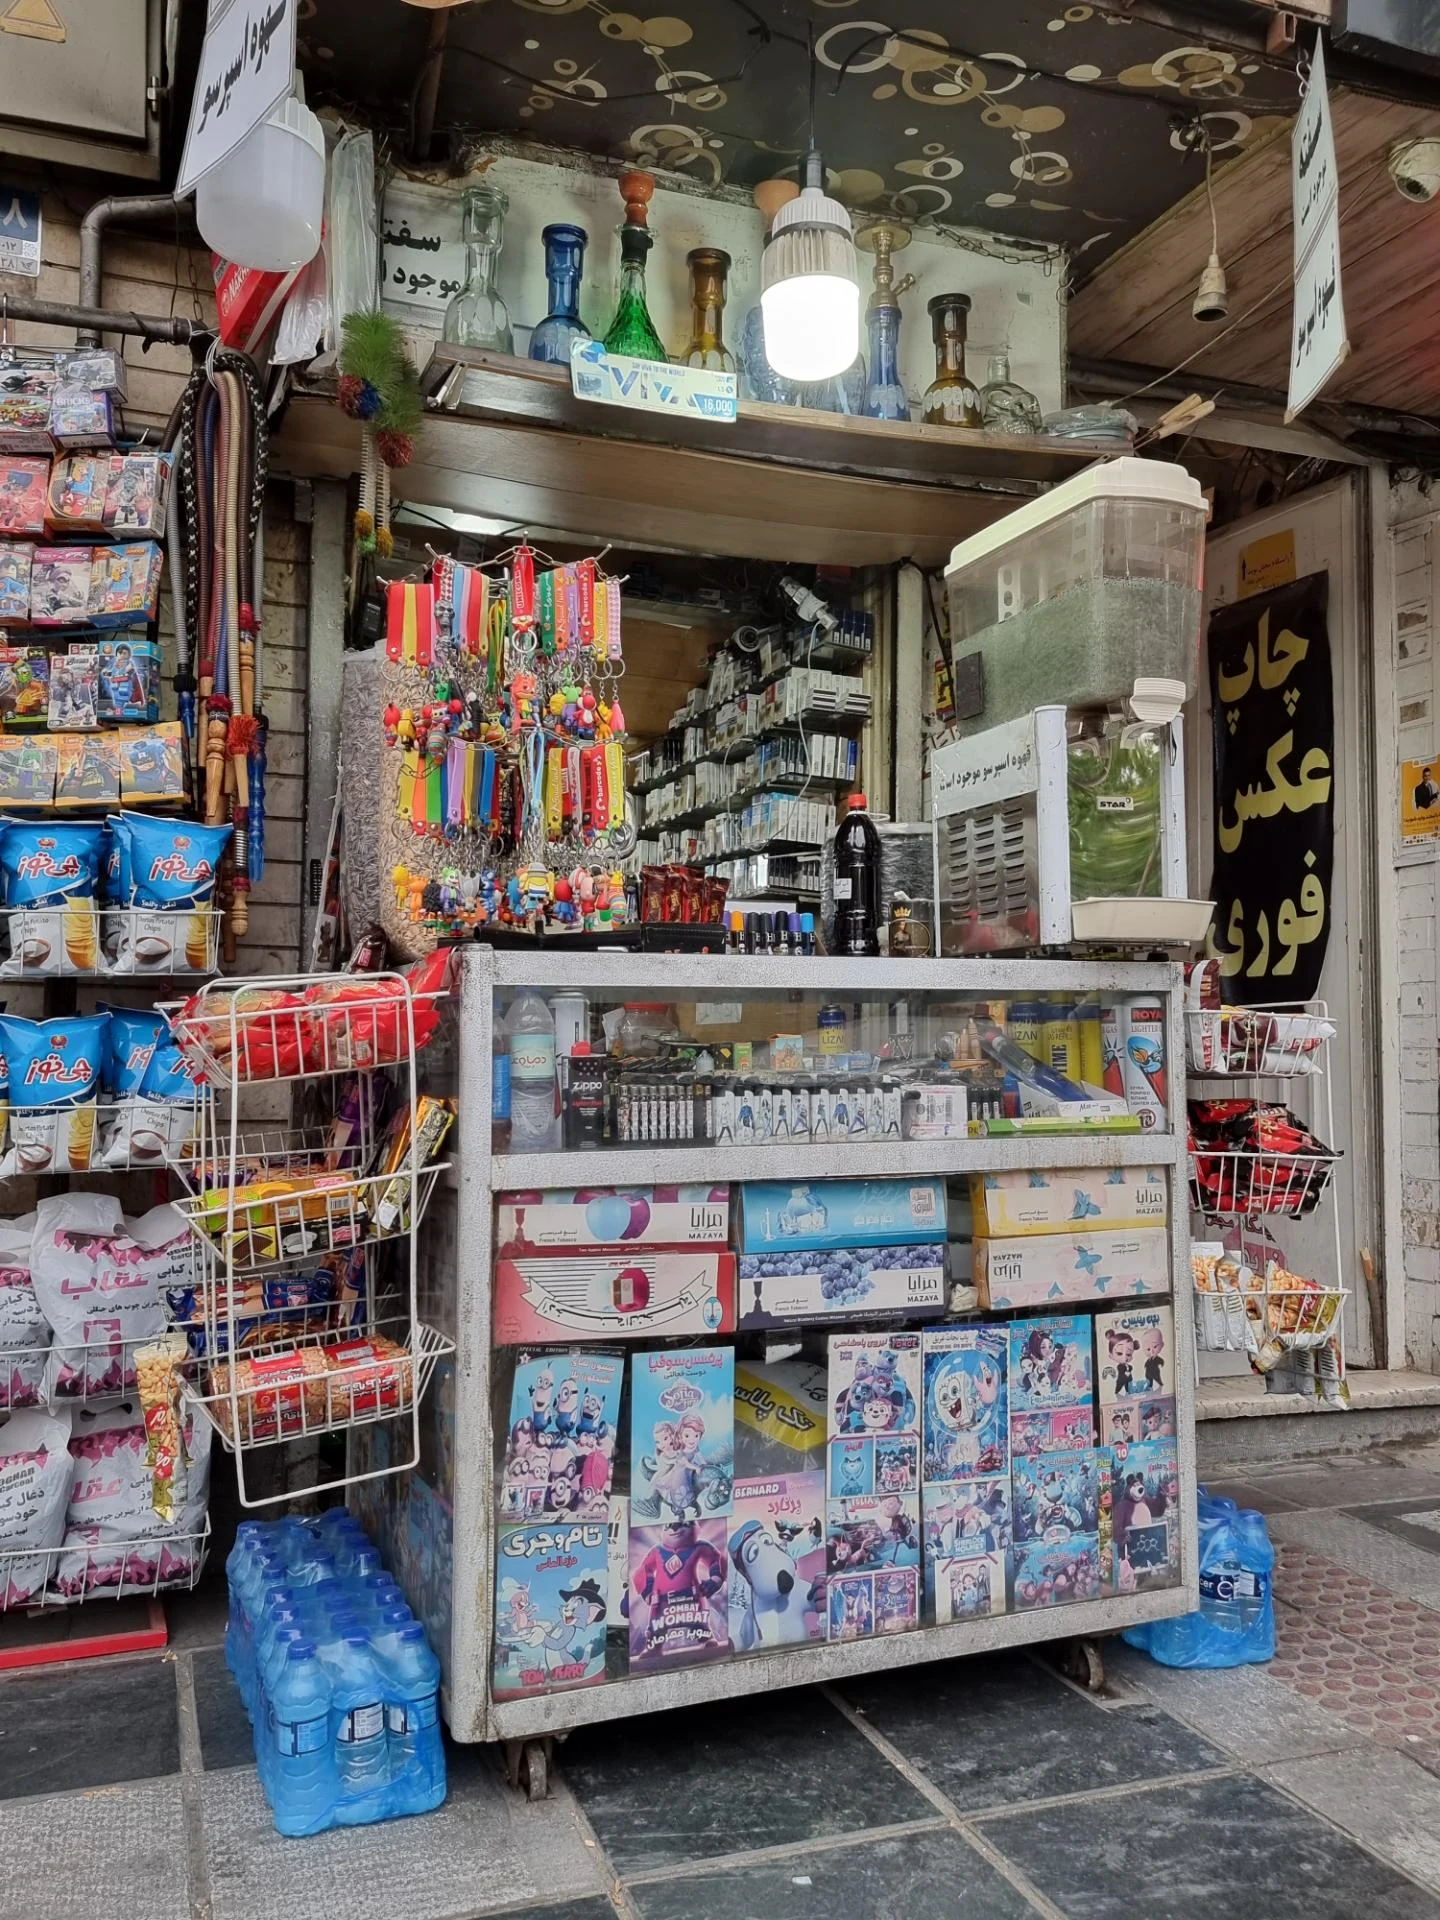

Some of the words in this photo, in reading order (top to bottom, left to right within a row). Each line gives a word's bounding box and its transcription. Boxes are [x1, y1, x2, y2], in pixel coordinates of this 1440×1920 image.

[250, 0, 287, 74] هوه
[197, 10, 249, 134] اسپرسو
[383, 219, 441, 252] سفت
[393, 266, 460, 299] موجود
[1218, 607, 1309, 735] چاپ
[983, 752, 1010, 782] اسپرسو
[1012, 744, 1031, 770] قهوه
[957, 771, 980, 789] موجود
[1218, 730, 1331, 854] عکس
[1100, 800, 1126, 809] STAR
[1206, 850, 1326, 978] فوری
[1132, 1010, 1164, 1020] ROYA
[690, 1207, 723, 1229] مزایا
[689, 1232, 723, 1240] MAZAYA
[157, 1263, 185, 1280] کبابی
[908, 1274, 938, 1292] مزایا
[60, 1271, 149, 1300] عقاب
[907, 1295, 939, 1303] MAZAYA
[71, 1477, 123, 1504] عقا
[735, 1484, 779, 1498] BERNARD
[0, 1505, 38, 1527] خودسو
[503, 1532, 554, 1558] جری
[564, 1525, 603, 1552] تام
[652, 1610, 709, 1631] WOMBAT
[663, 1603, 699, 1616] COMBAT
